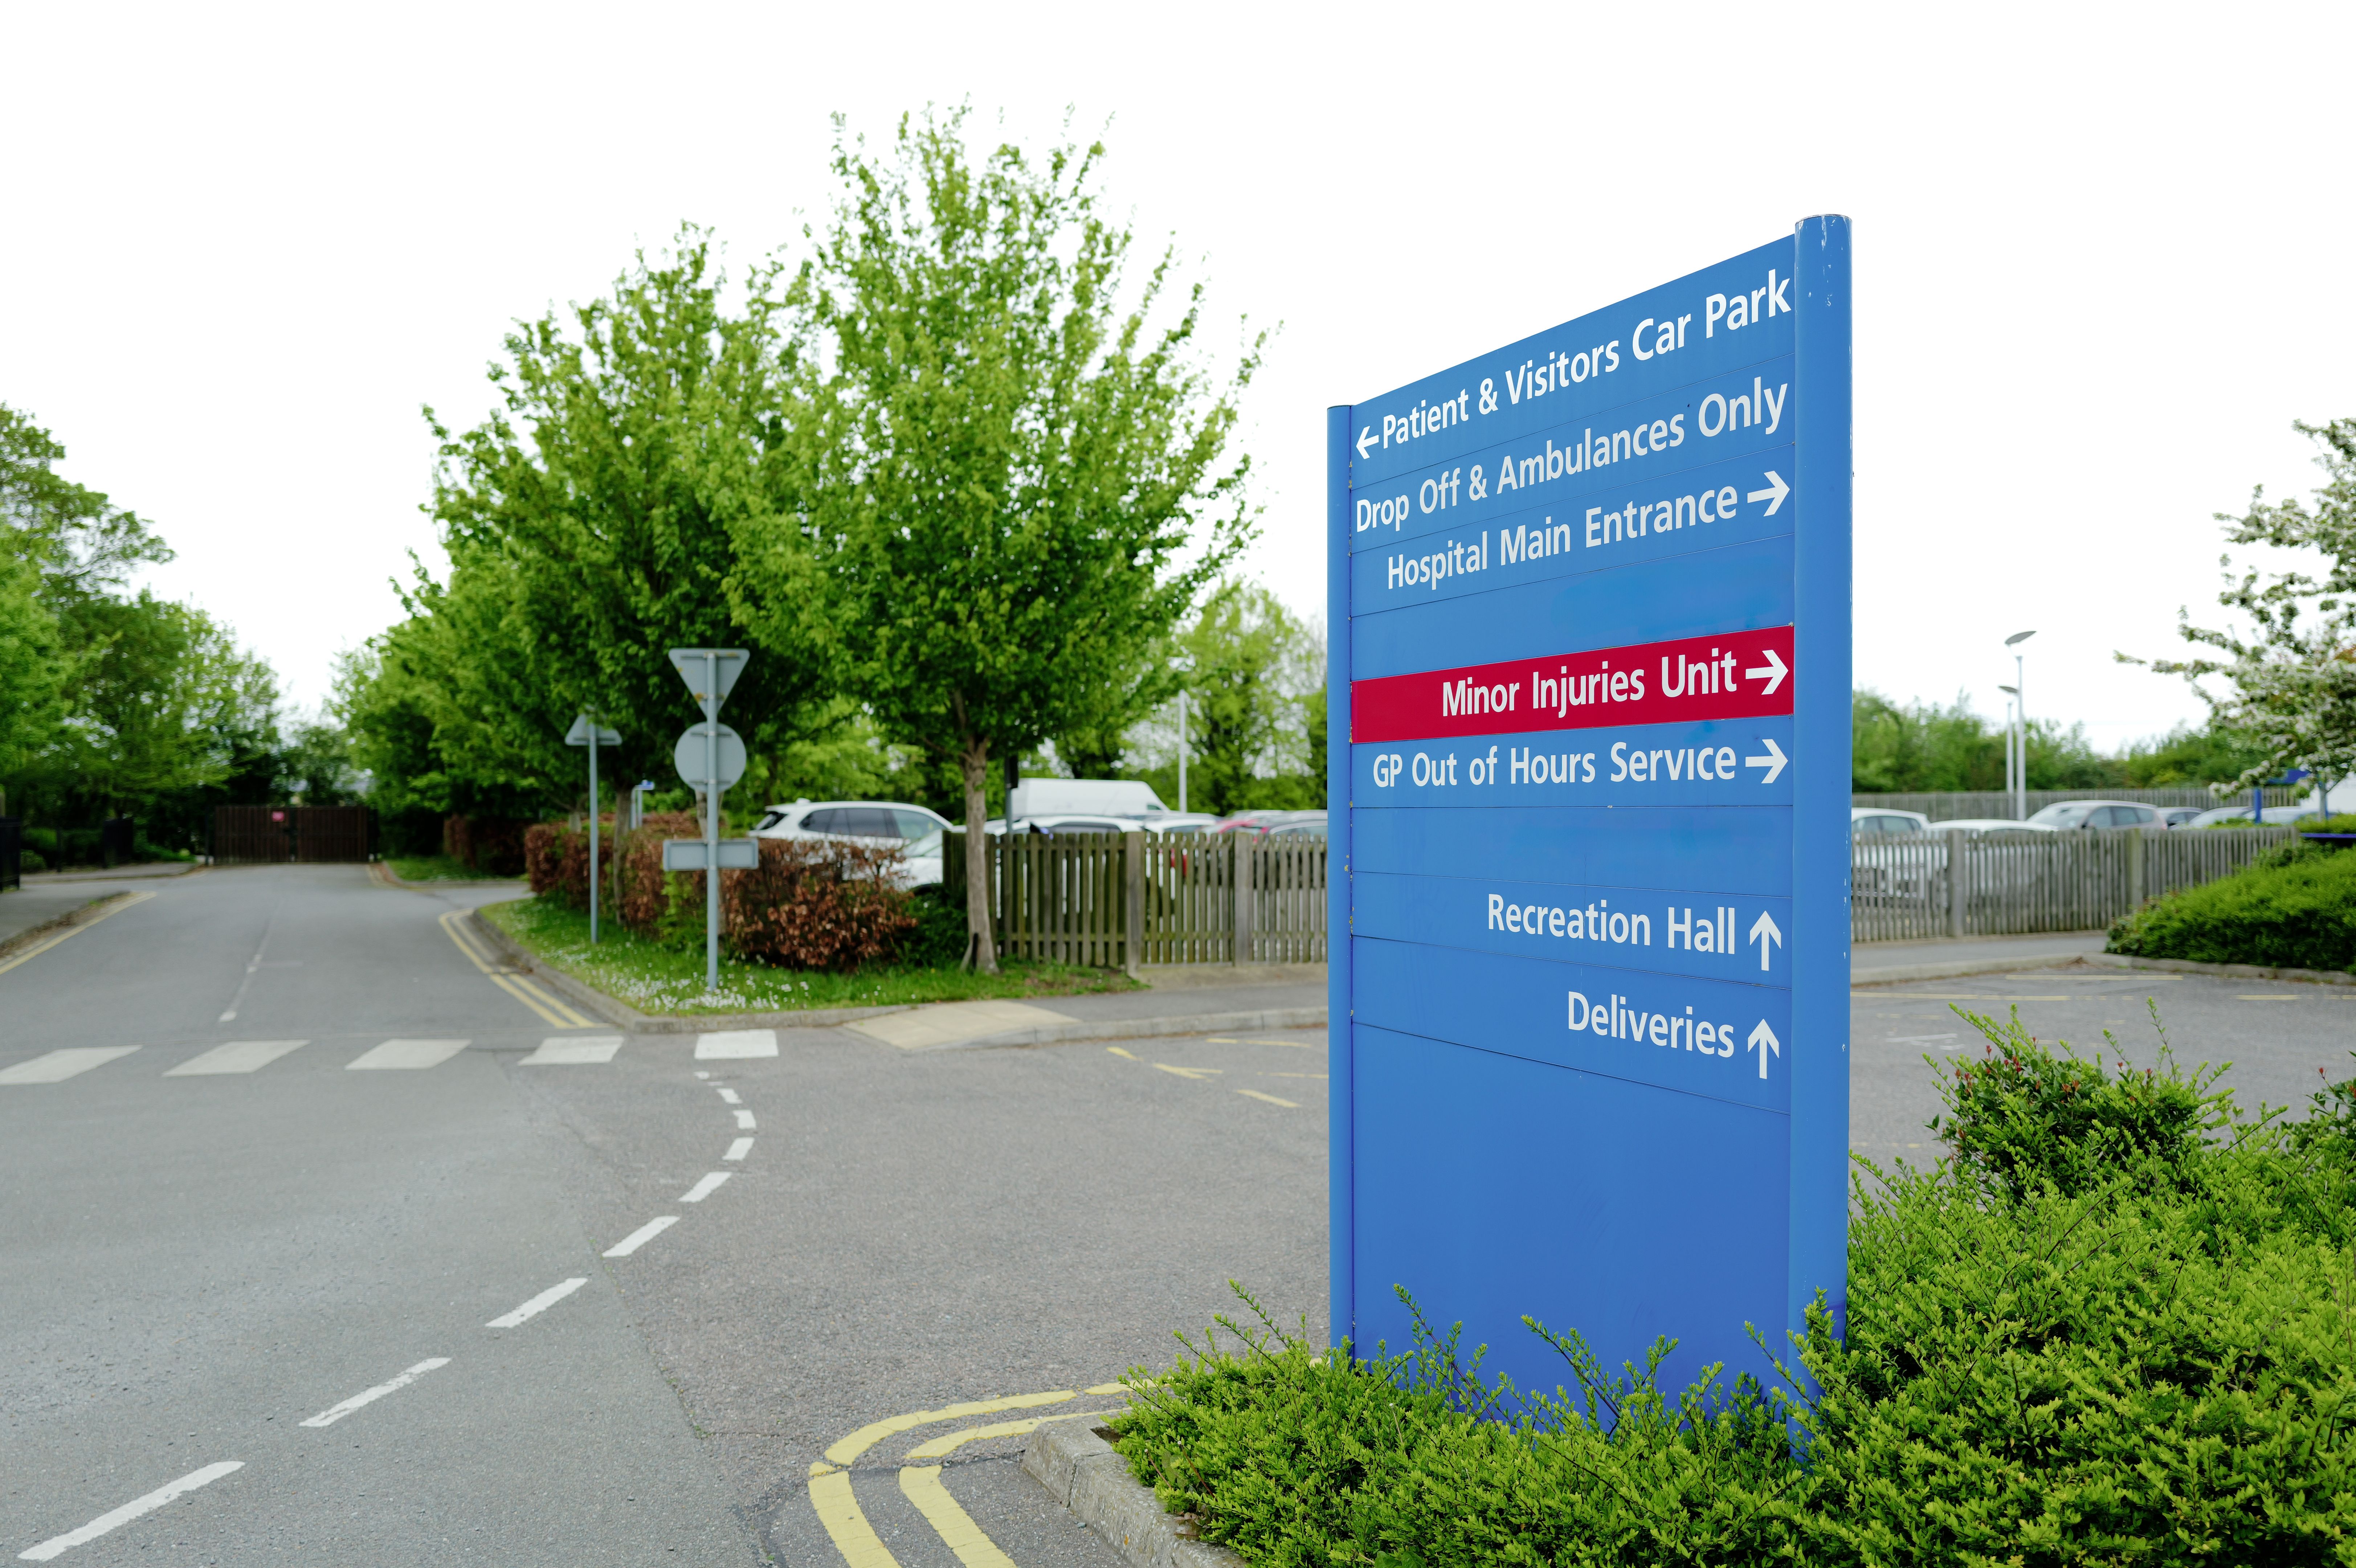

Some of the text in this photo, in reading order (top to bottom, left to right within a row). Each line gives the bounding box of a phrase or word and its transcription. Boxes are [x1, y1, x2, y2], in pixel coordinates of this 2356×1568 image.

[1383, 269, 1792, 449] Patient & Visitors Car Park
[1357, 376, 1788, 532] Drop Off & Ambulances Only
[1388, 486, 1738, 590] Hospital Main Entrance
[1443, 648, 1737, 718] Minor Injuries Unit
[1373, 742, 1736, 787] GP Out of Hours Service
[1489, 894, 1735, 954] Recreation Hall
[1568, 991, 1734, 1058] Deliveries
